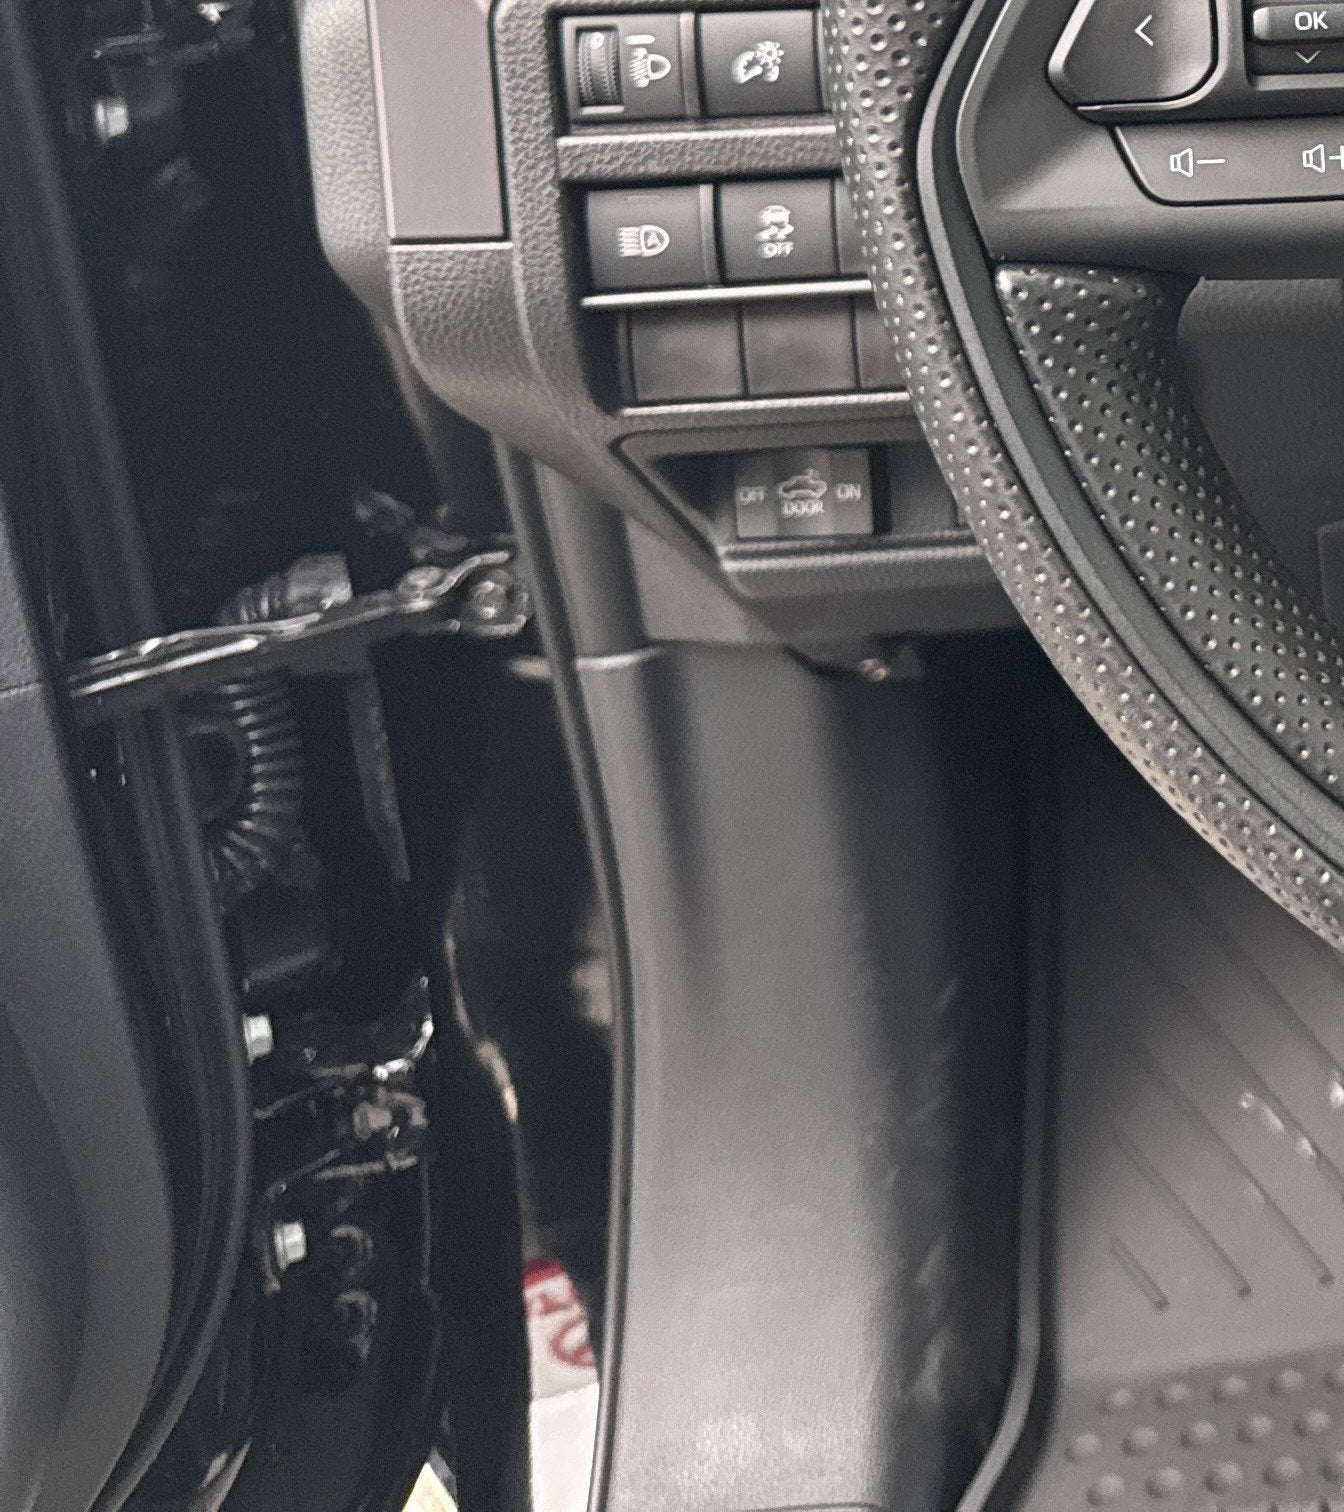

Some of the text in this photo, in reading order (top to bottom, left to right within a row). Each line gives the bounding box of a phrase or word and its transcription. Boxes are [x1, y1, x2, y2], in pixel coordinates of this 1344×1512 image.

[1294, 10, 1328, 31] OK
[763, 242, 795, 259] OFF
[835, 483, 861, 503] ON
